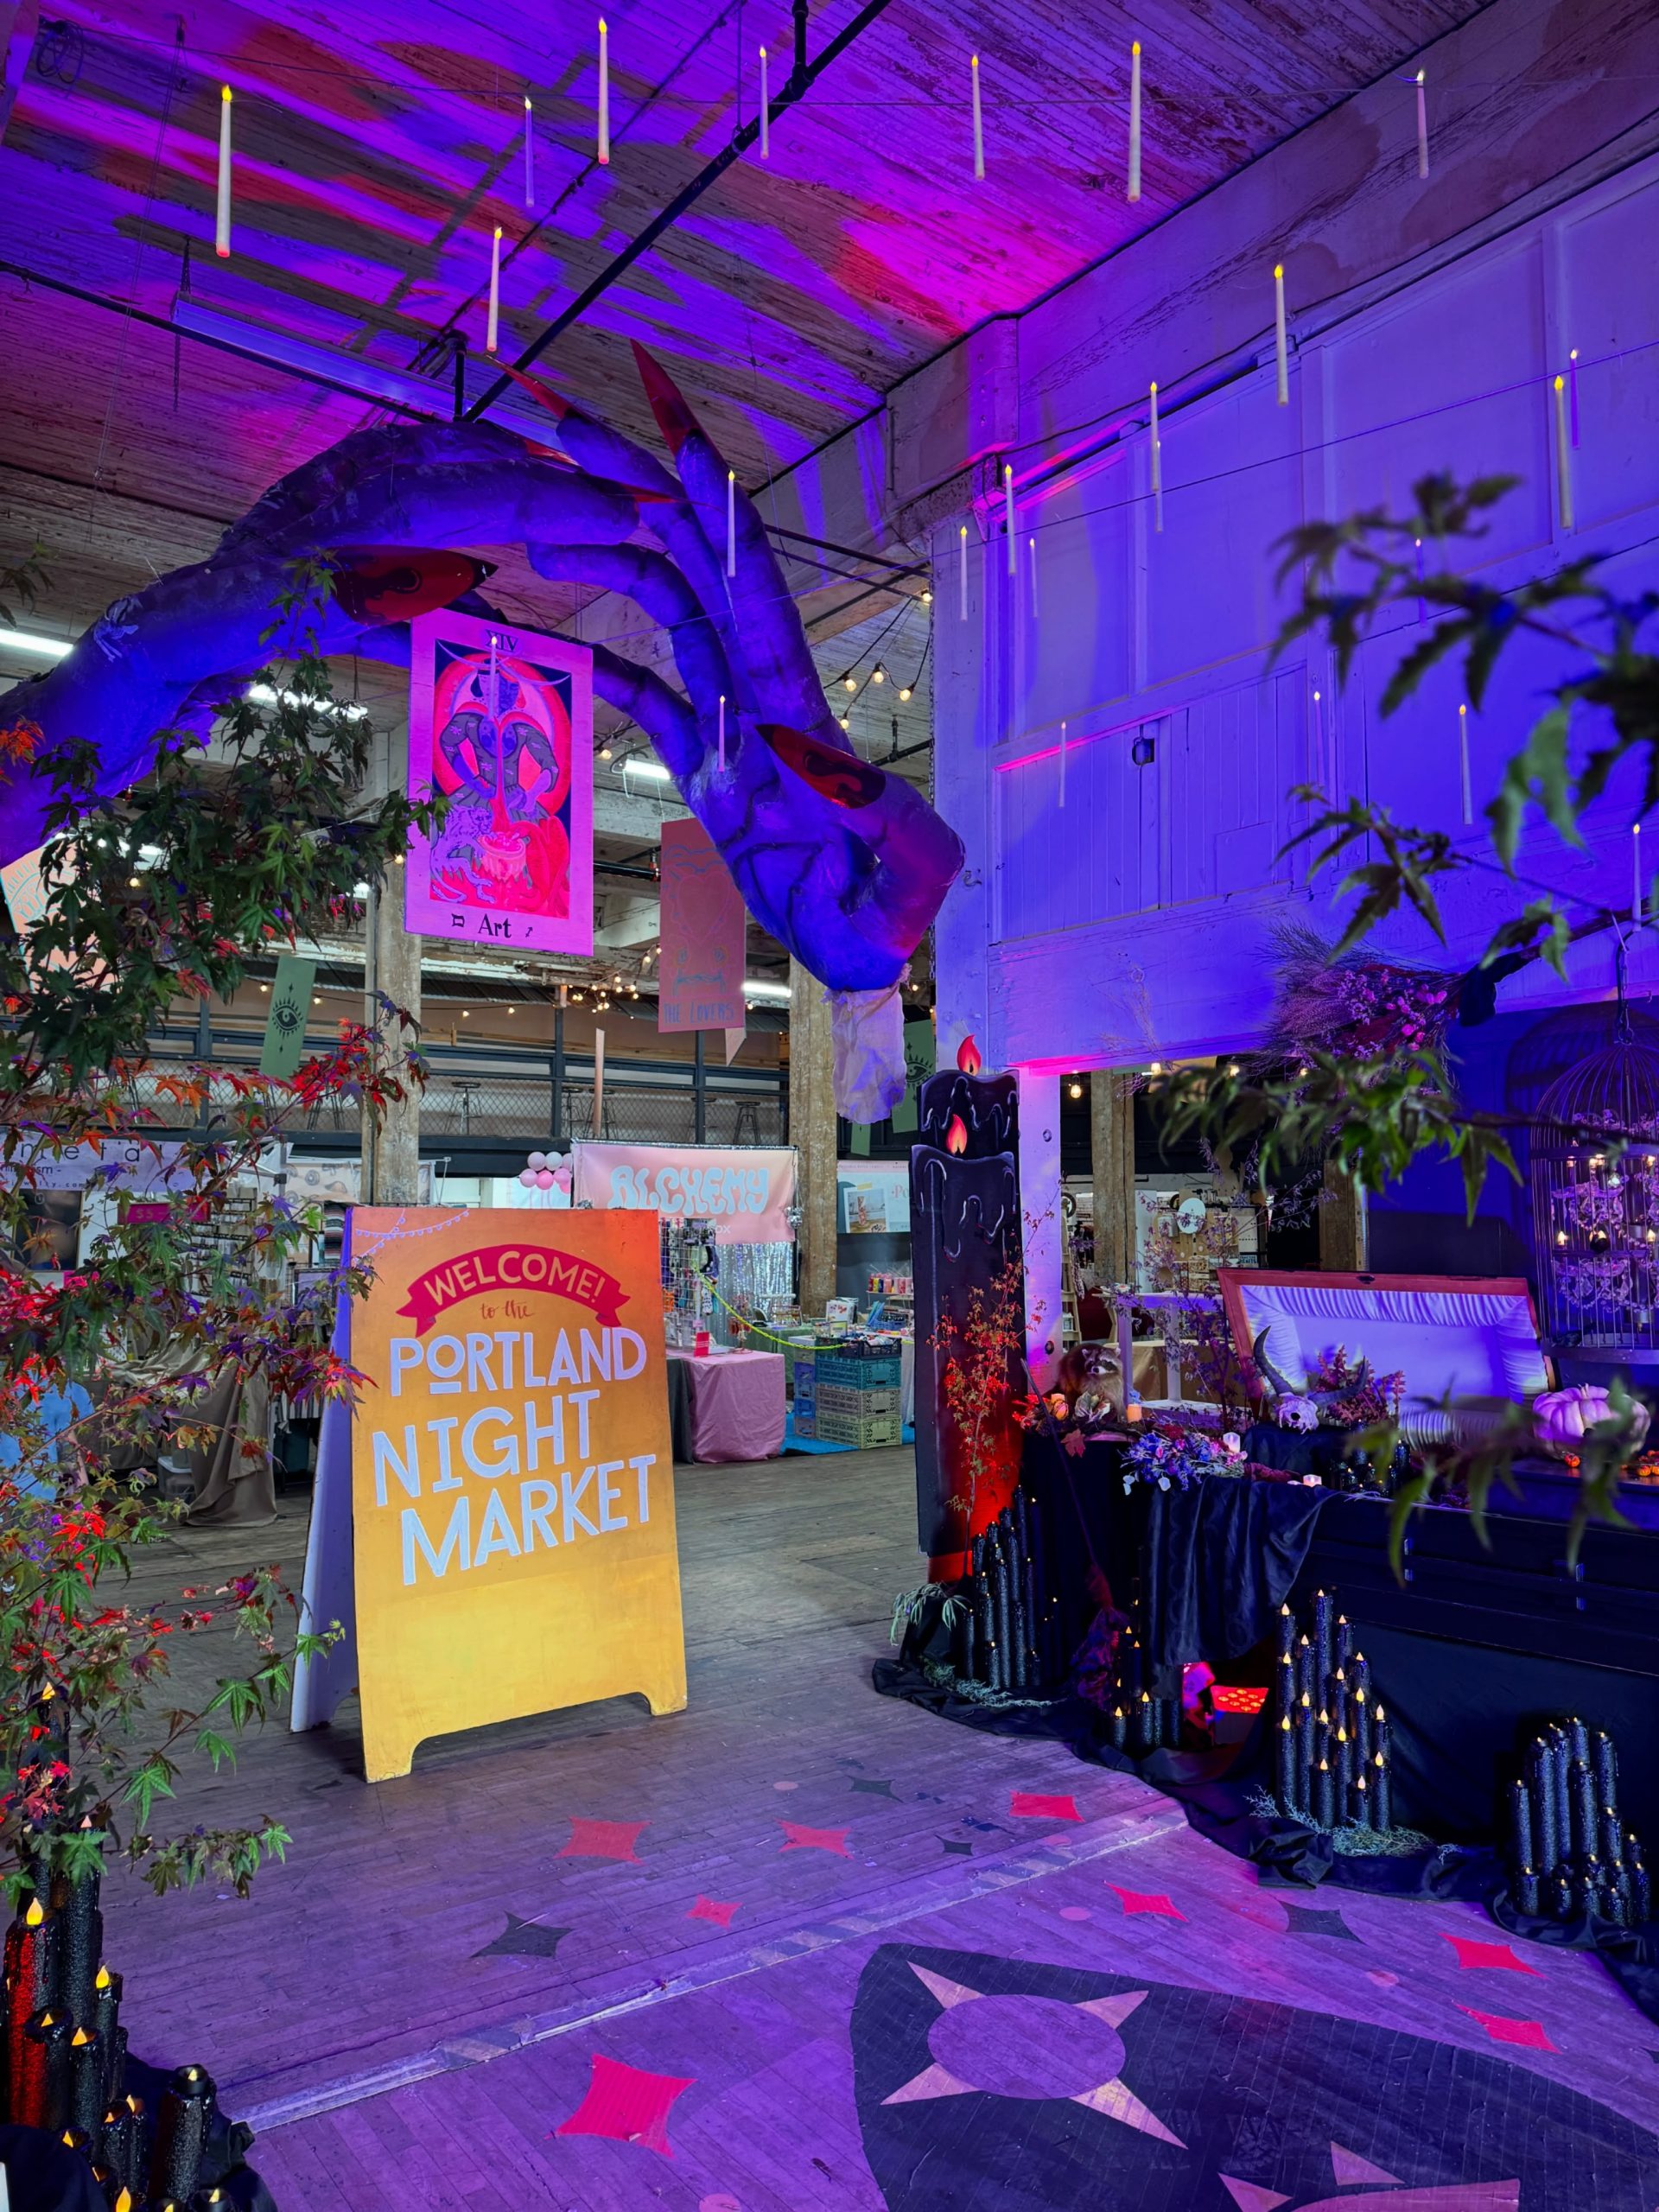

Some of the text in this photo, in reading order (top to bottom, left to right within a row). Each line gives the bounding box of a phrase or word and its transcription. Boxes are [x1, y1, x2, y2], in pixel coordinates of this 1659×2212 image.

[485, 629, 518, 652] XIV
[478, 913, 512, 938] Art
[663, 1001, 734, 1024] THE LOVERS
[608, 1166, 769, 1215] ALCHEMY
[424, 1250, 606, 1306] WELCOME!
[480, 1300, 535, 1319] to the
[389, 1327, 648, 1397] PORTLAND
[372, 1389, 601, 1507] NIGHT
[401, 1453, 657, 1586] MARKET
